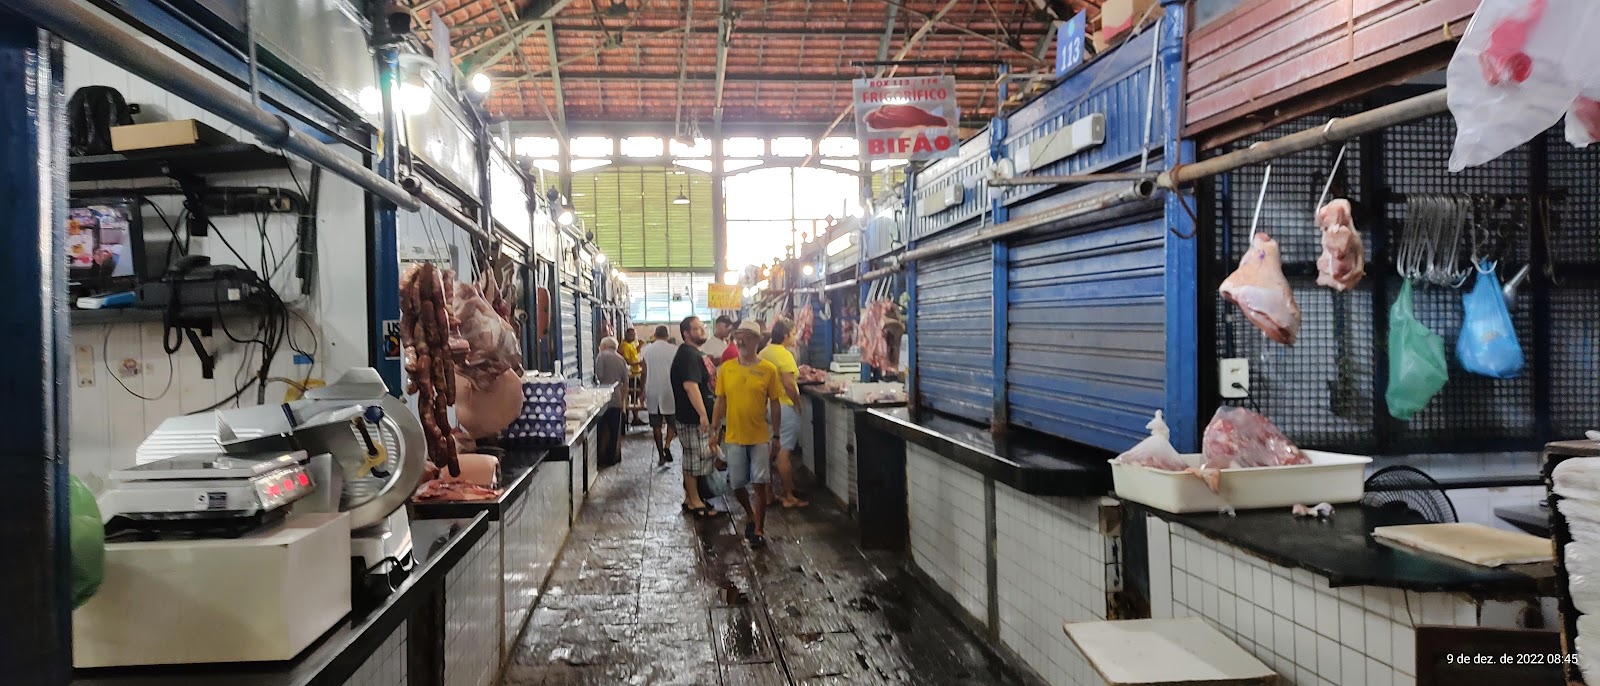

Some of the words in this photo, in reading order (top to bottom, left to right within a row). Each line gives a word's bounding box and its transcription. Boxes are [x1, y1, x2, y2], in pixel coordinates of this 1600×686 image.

[1061, 37, 1080, 71] 113
[870, 80, 888, 88] BOX
[862, 87, 947, 103] FRIGORÍFICO
[868, 132, 951, 155] BIFÃO
